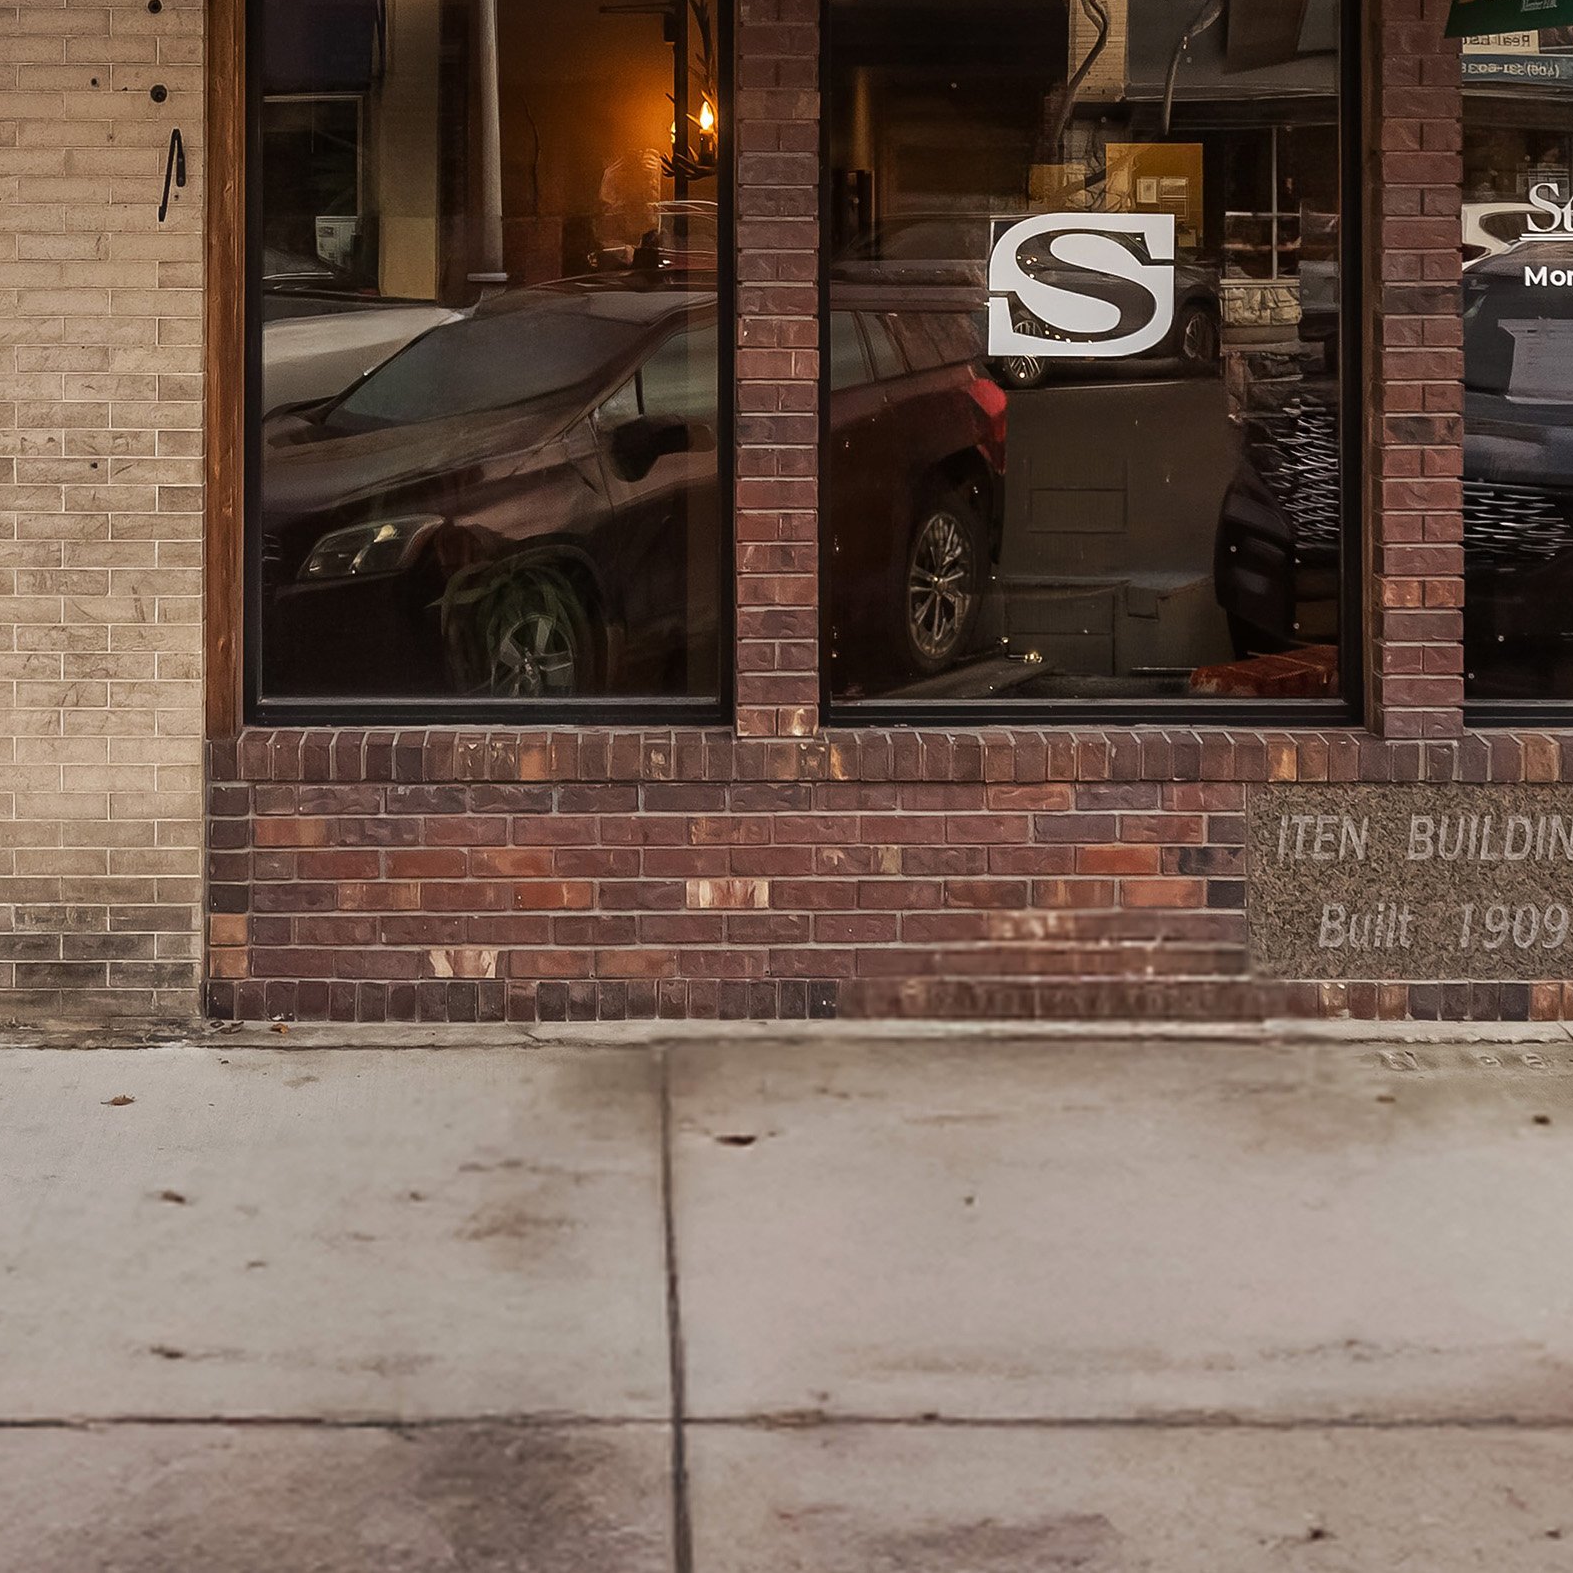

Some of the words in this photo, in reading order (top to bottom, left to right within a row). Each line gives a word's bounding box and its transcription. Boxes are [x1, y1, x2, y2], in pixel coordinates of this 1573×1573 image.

[1276, 814, 1370, 861] ITEN
[1318, 902, 1414, 949] Built
[1458, 902, 1572, 949] 1909
